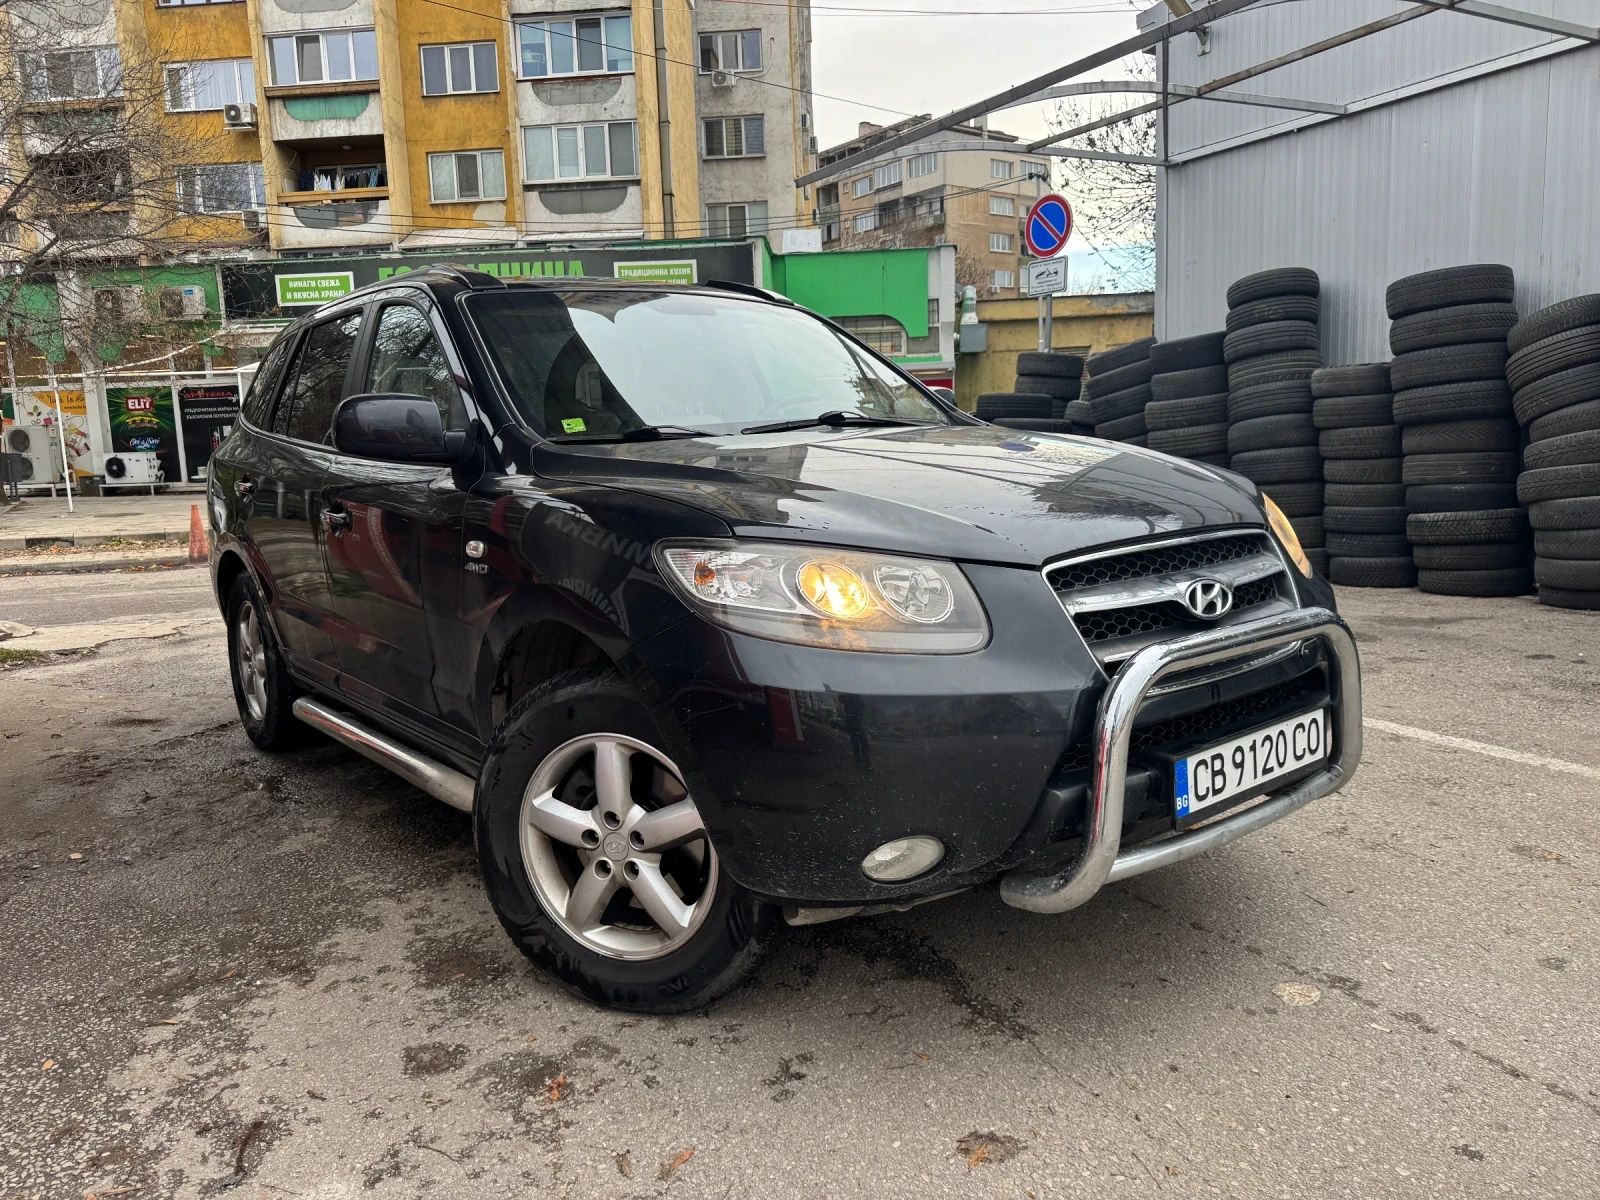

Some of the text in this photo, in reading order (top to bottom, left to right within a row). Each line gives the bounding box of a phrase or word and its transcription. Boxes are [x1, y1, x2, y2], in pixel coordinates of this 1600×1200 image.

[621, 267, 691, 277] ТРАДИЦИОННА КУХНЯ
[288, 279, 340, 288] ВИНАГИ СВЕЖА
[293, 290, 319, 299] ВКУСНА
[464, 562, 489, 574] 4WD
[1193, 717, 1320, 802] CB 9120 CO
[1176, 794, 1188, 810] BG
